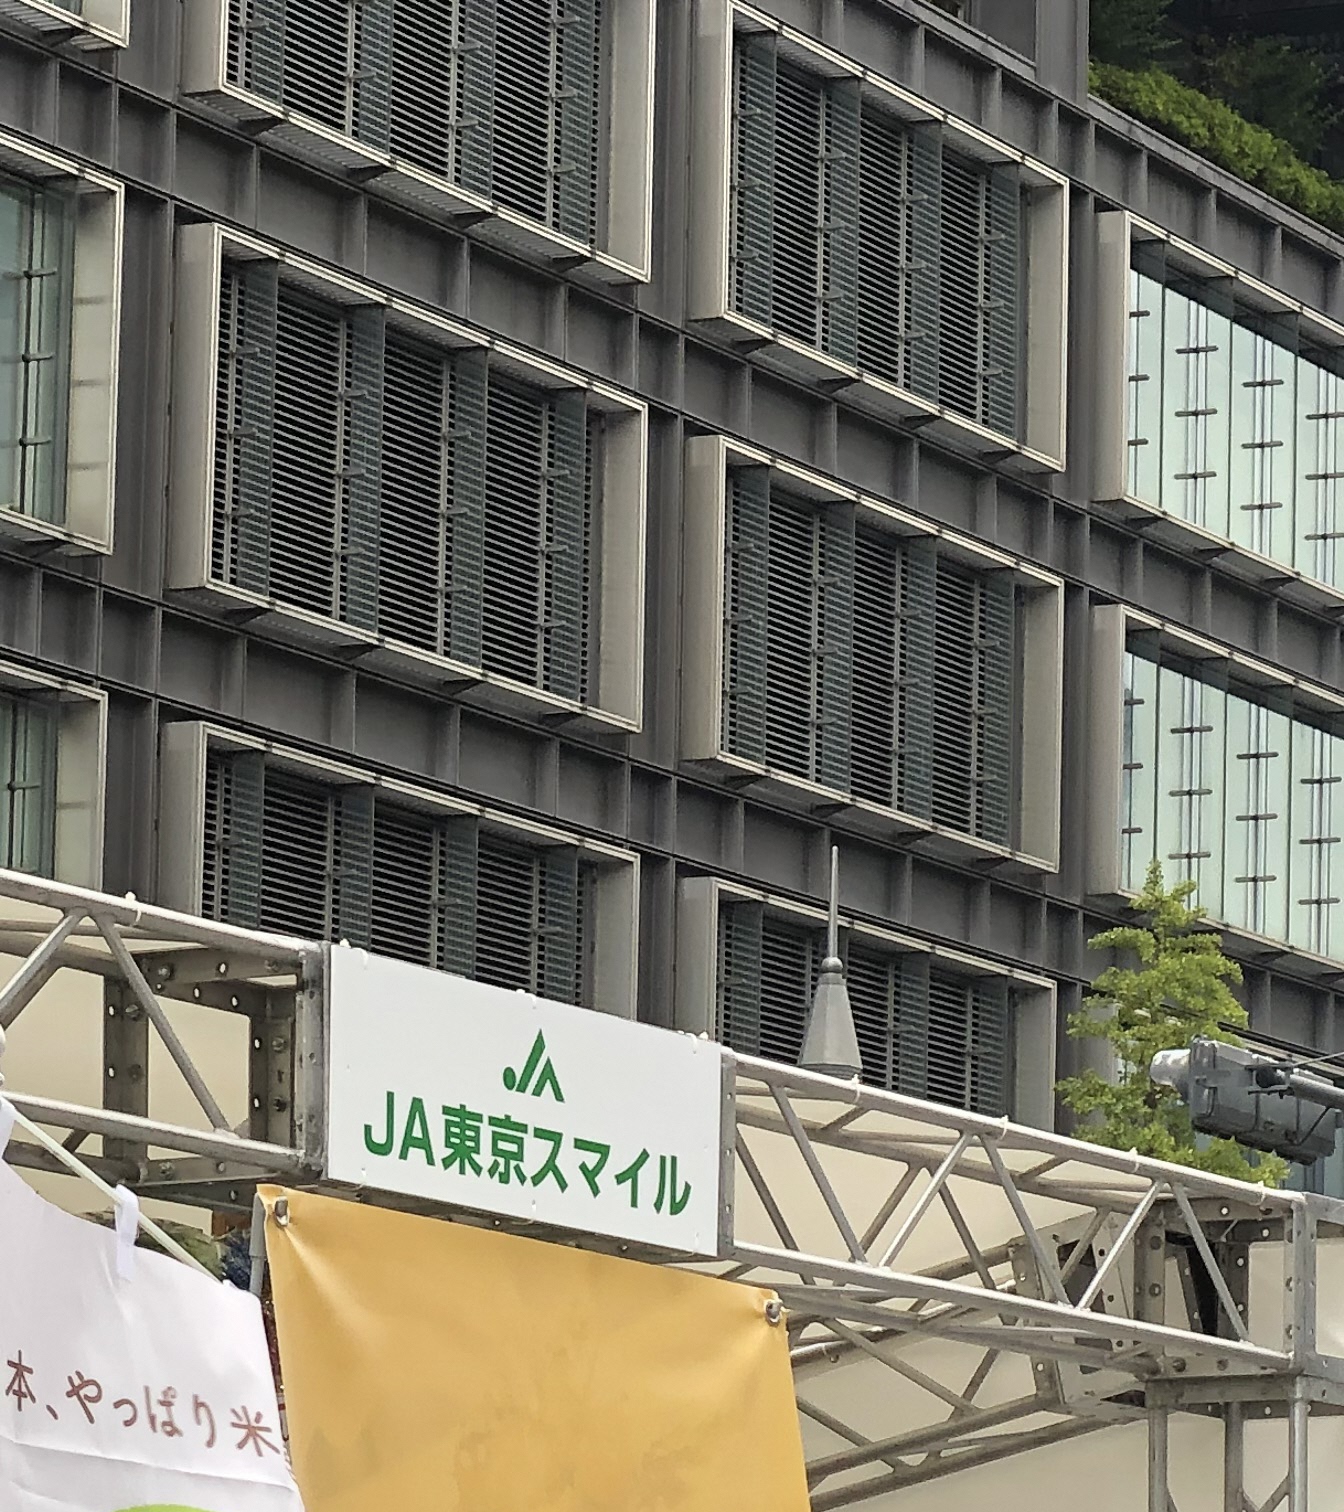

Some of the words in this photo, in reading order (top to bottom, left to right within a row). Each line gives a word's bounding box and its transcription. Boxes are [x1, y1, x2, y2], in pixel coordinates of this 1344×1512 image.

[363, 1091, 693, 1218] JA東京スマイル
